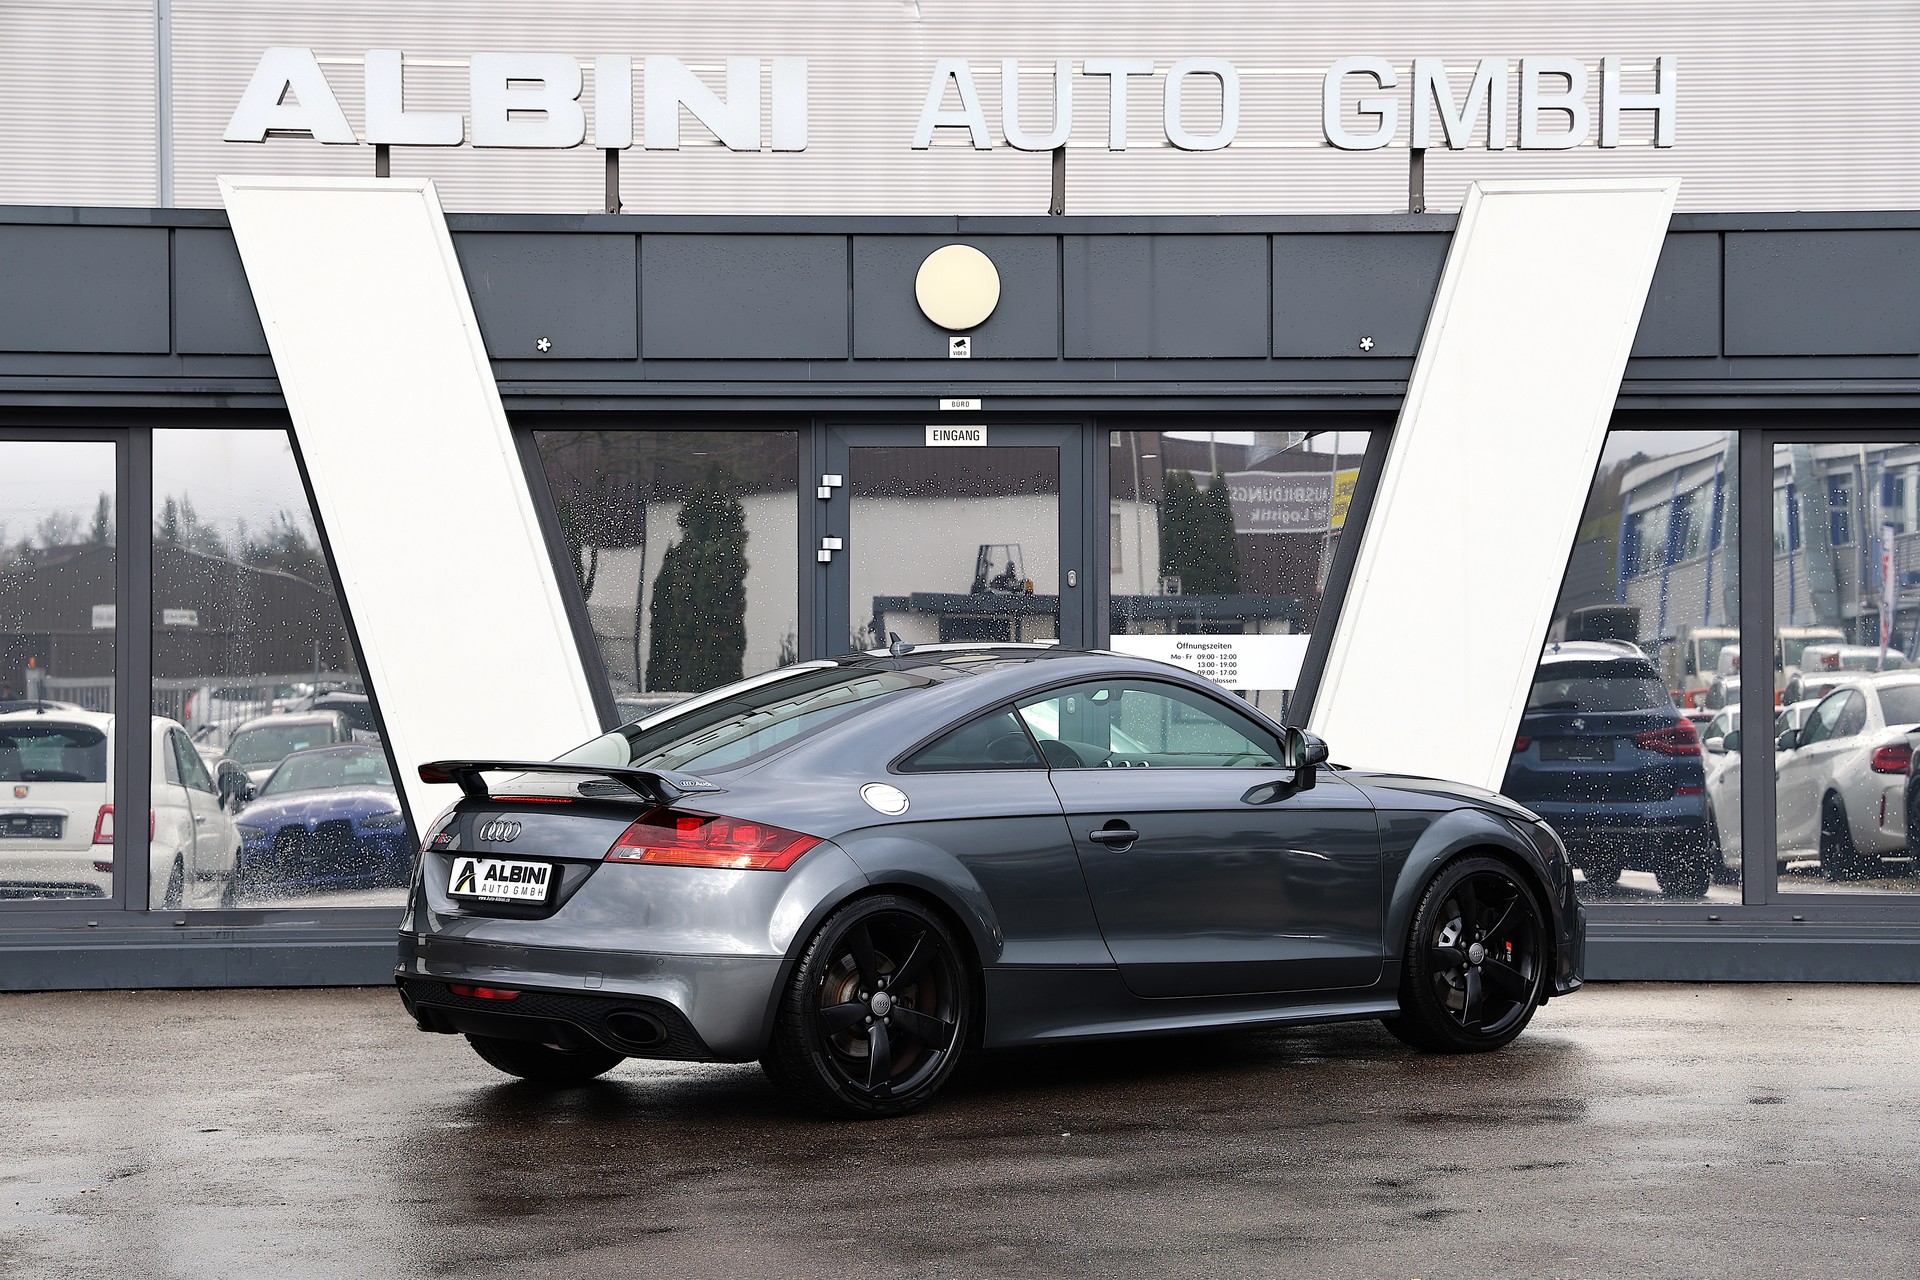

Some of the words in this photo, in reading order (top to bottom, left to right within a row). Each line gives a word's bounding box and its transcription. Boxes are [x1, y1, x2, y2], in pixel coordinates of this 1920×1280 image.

[223, 47, 809, 152] ALBINI
[911, 56, 1240, 151] AUTO
[1322, 55, 1678, 151] GMBH
[951, 400, 970, 408] BÜRO
[933, 430, 980, 441] EINGANG
[1176, 641, 1232, 651] Öffnungszeiten
[484, 864, 548, 885] ALBINI
[481, 884, 509, 894] AUTO
[513, 886, 544, 897] GMBH
